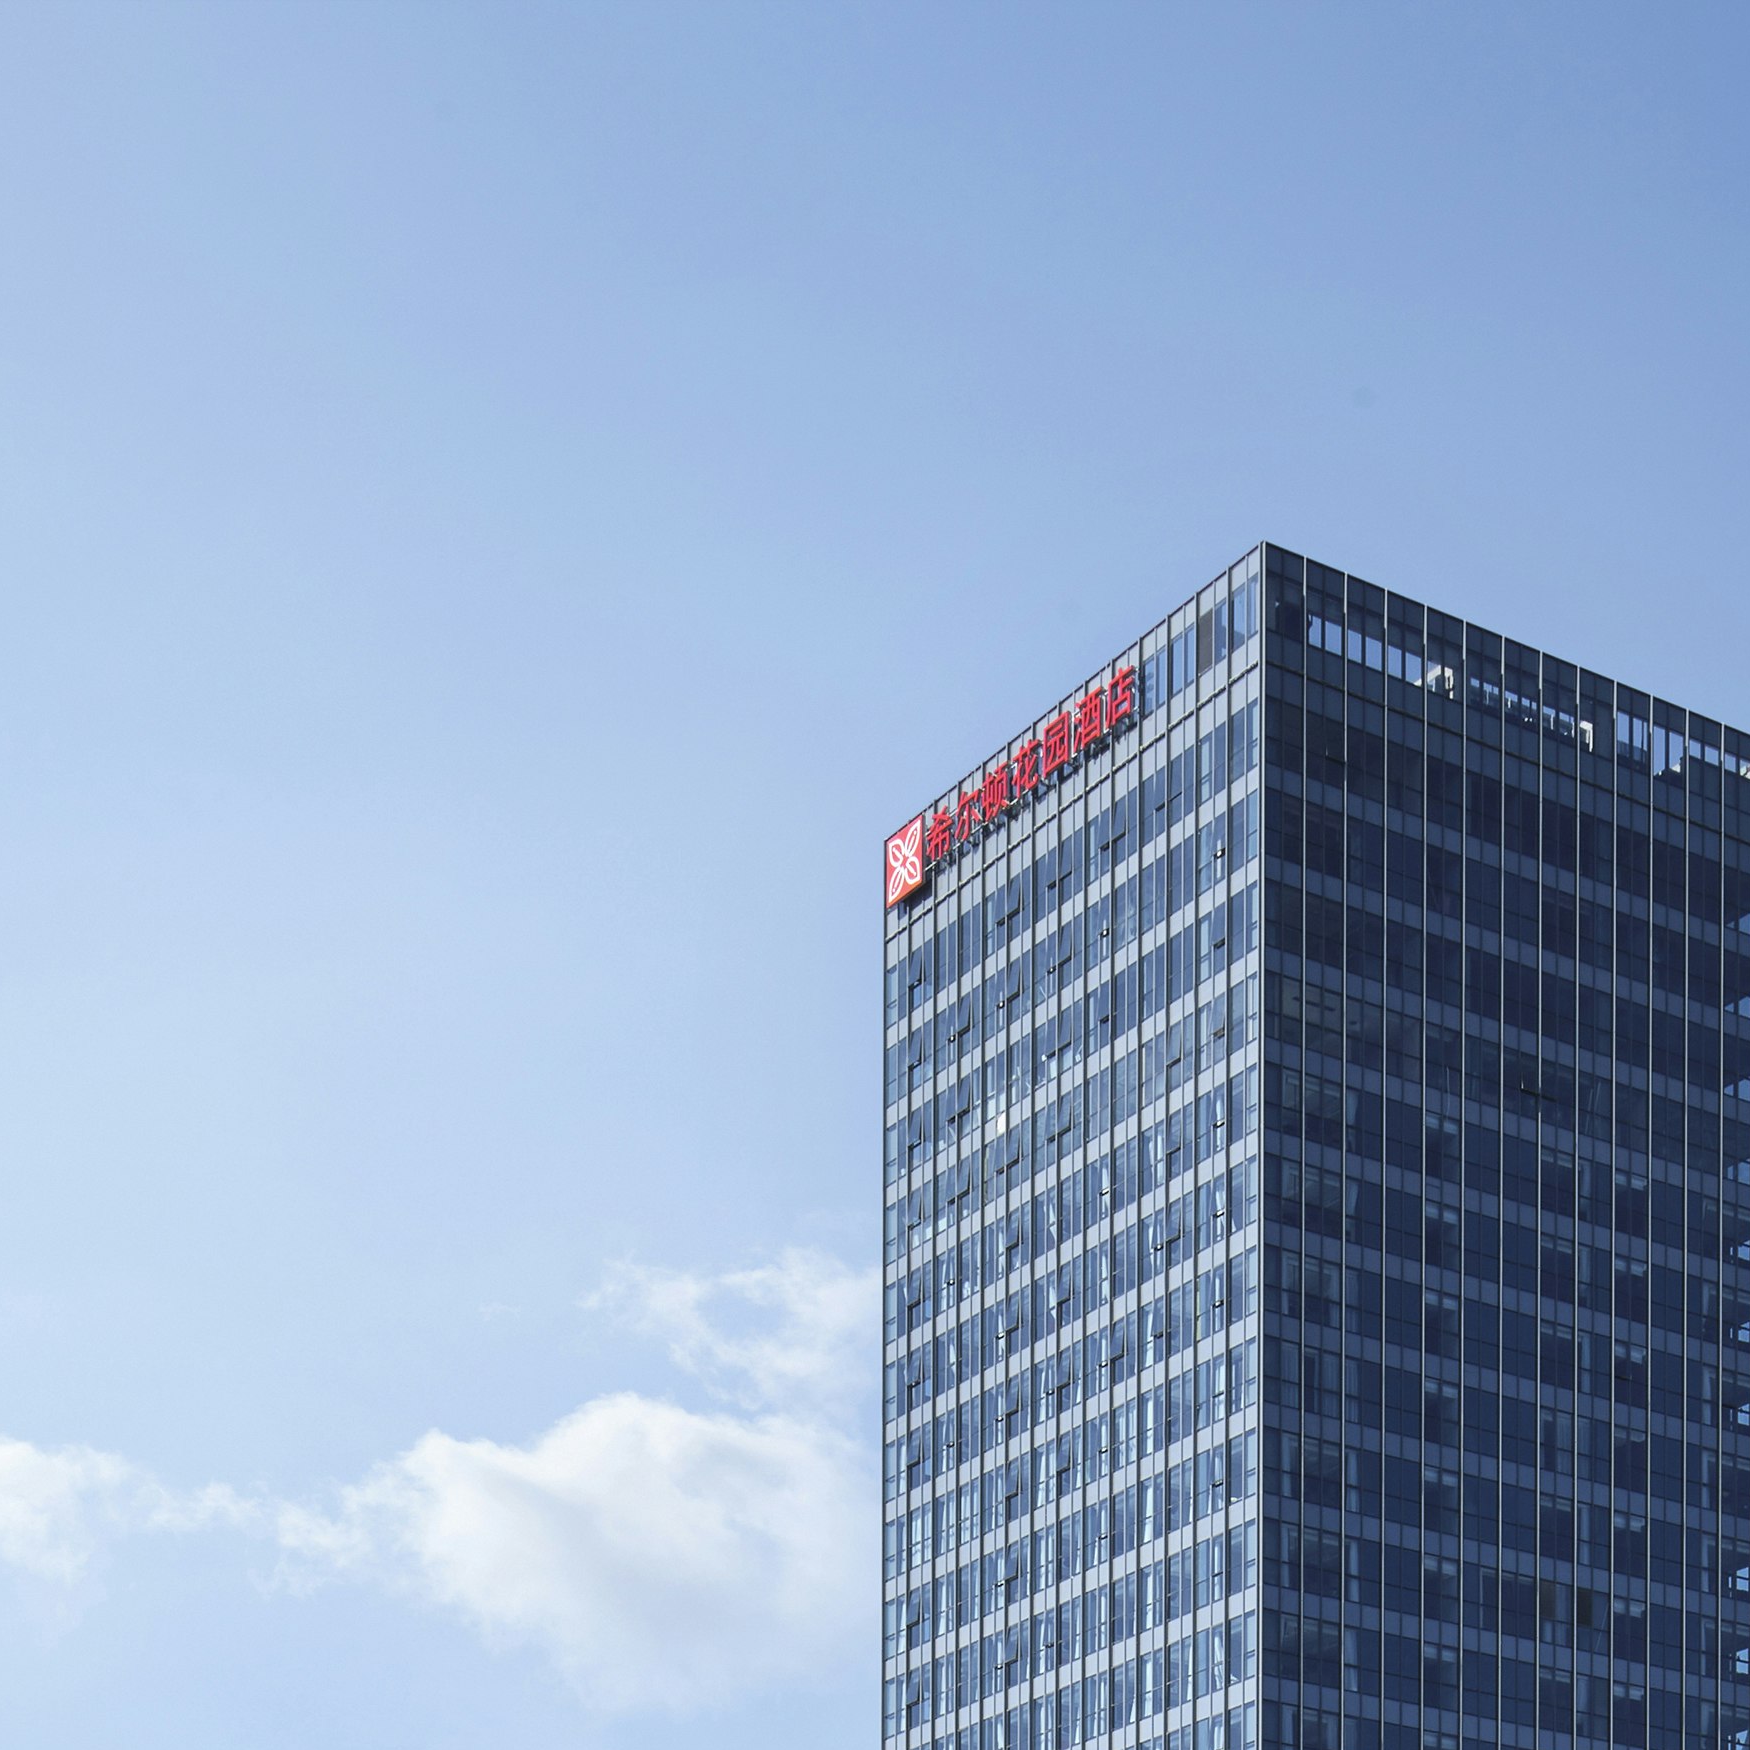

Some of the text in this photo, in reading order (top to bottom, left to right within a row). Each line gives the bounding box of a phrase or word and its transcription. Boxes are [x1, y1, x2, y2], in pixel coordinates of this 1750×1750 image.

[926, 665, 1135, 861] 希尔顿花园酒店
